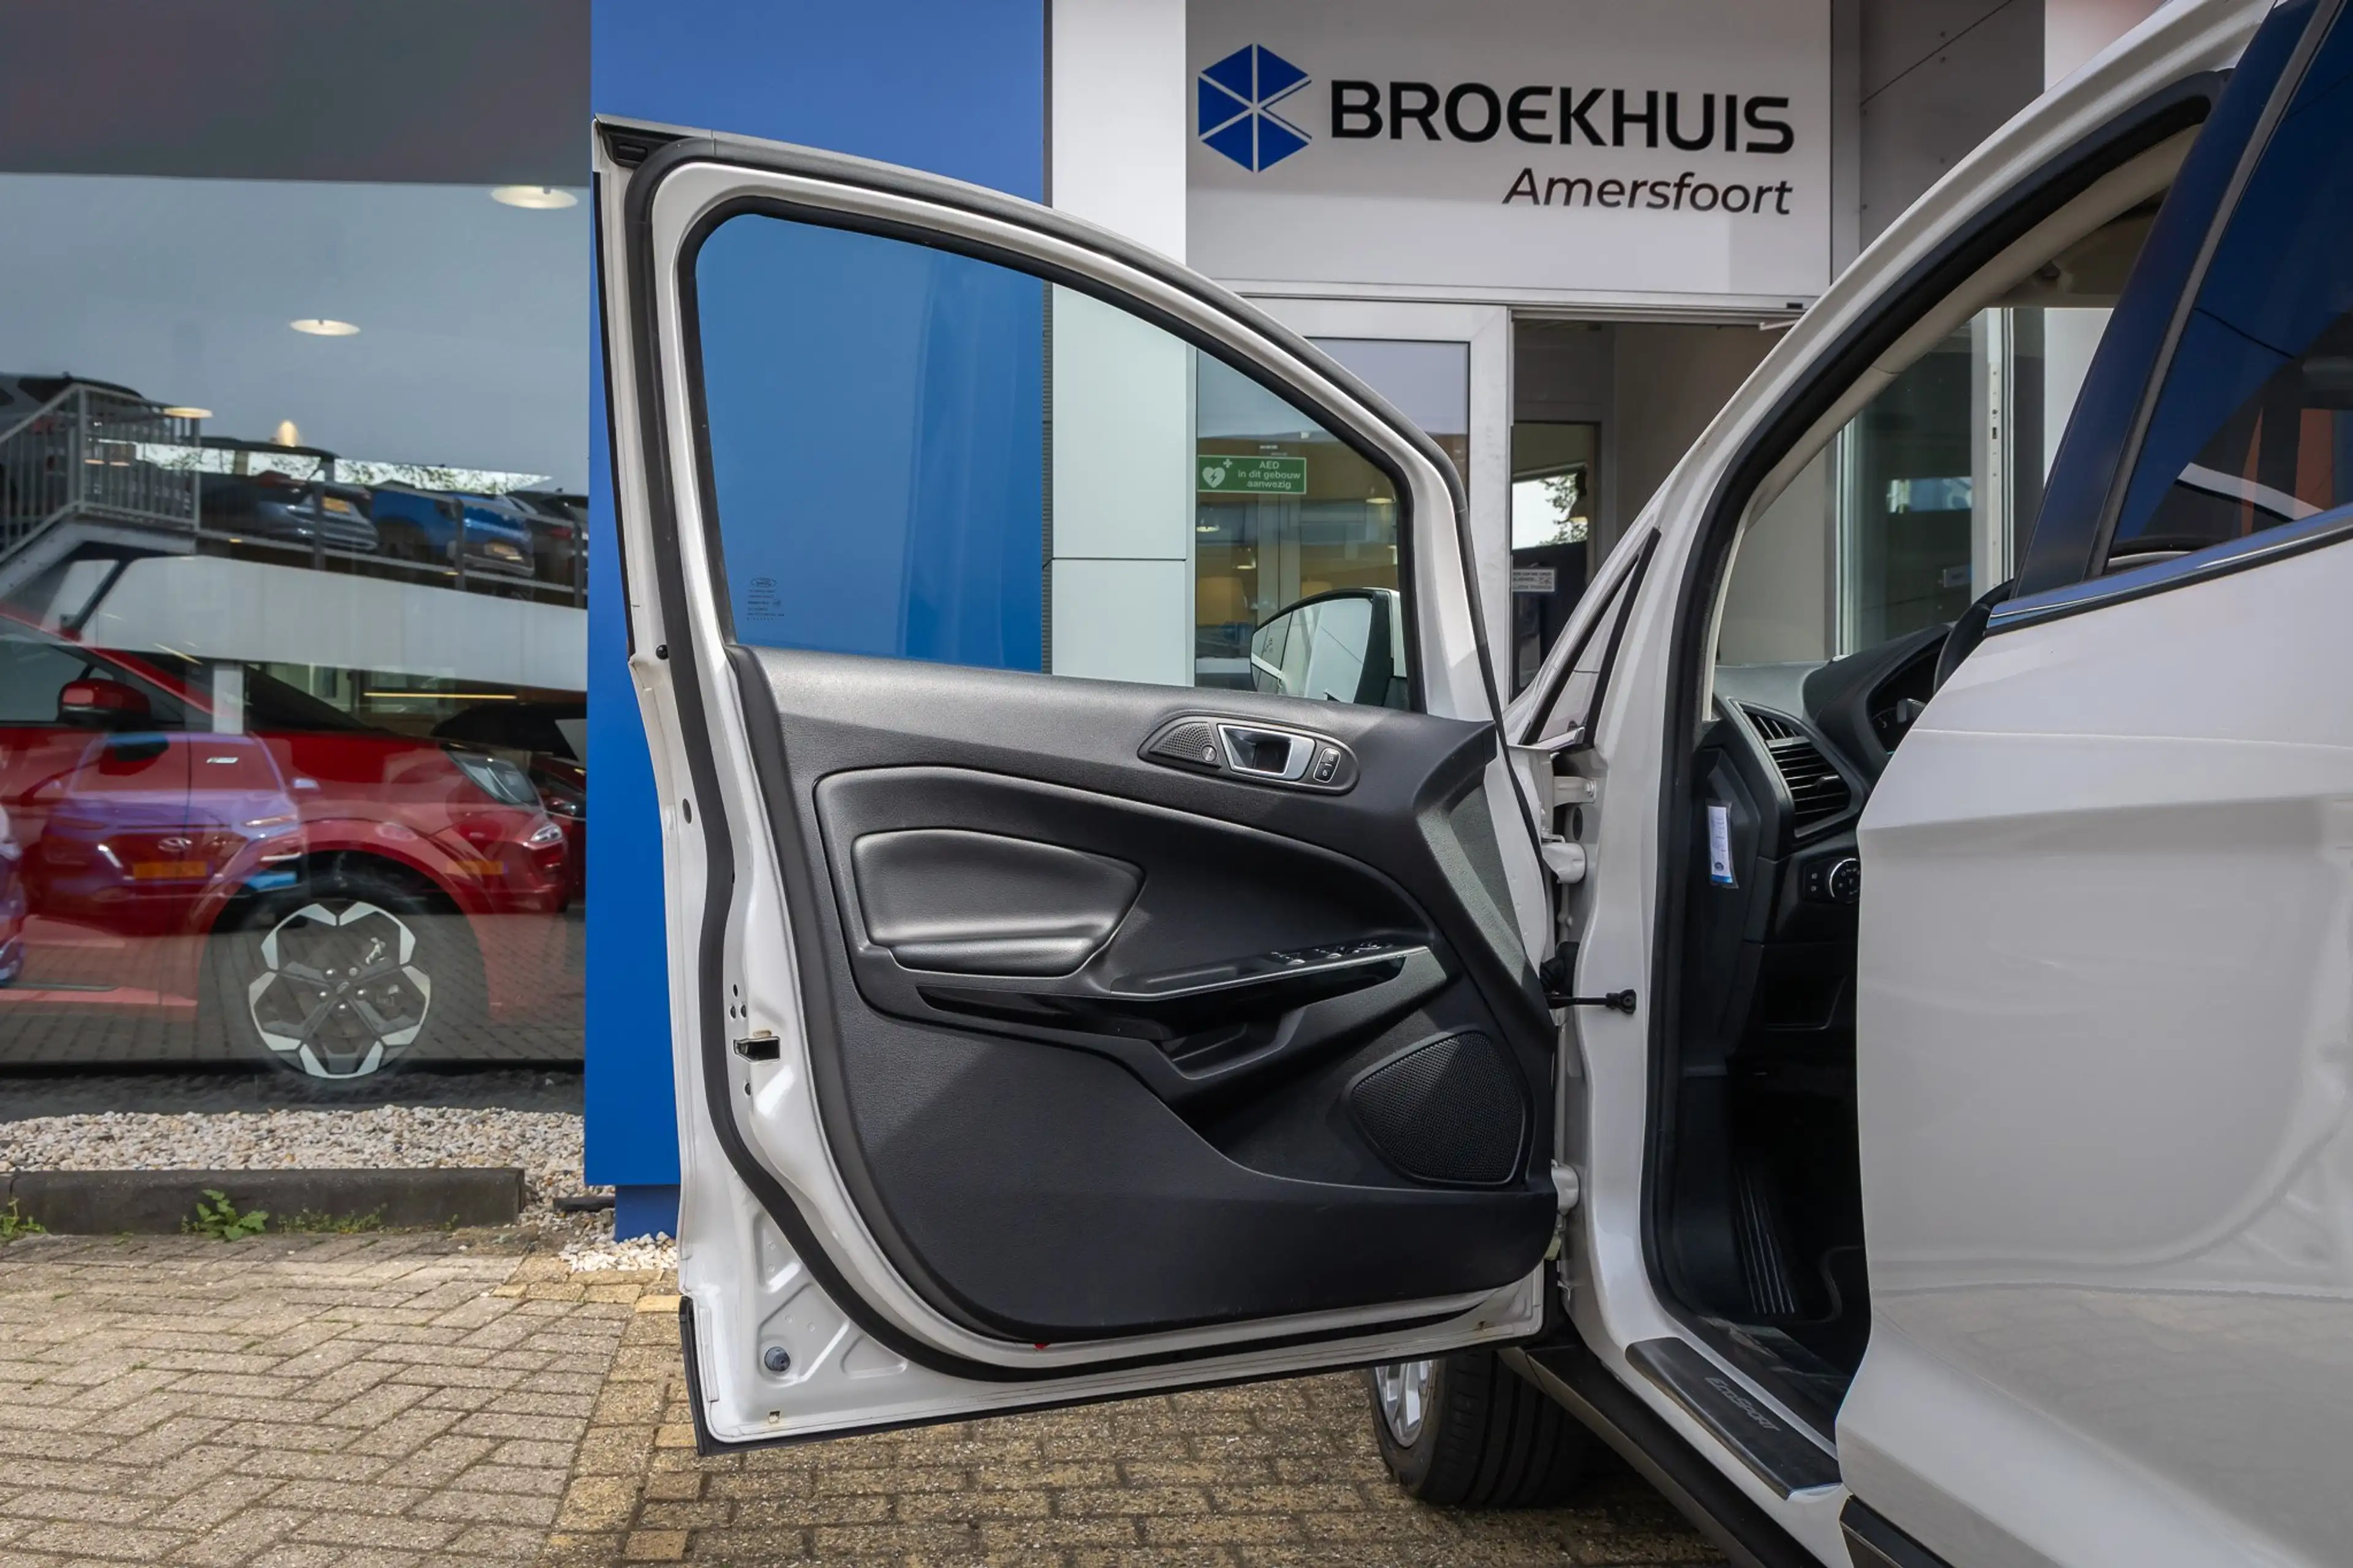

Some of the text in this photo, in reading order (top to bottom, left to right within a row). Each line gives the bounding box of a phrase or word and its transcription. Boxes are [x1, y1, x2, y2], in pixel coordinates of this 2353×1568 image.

[1330, 79, 1795, 155] BROEKHUIS
[1501, 167, 1794, 216] Amersfoort
[1259, 461, 1279, 469] AED
[1249, 470, 1261, 479] dit
[1264, 471, 1301, 480] gebouw
[1246, 480, 1292, 490] aanwezig
